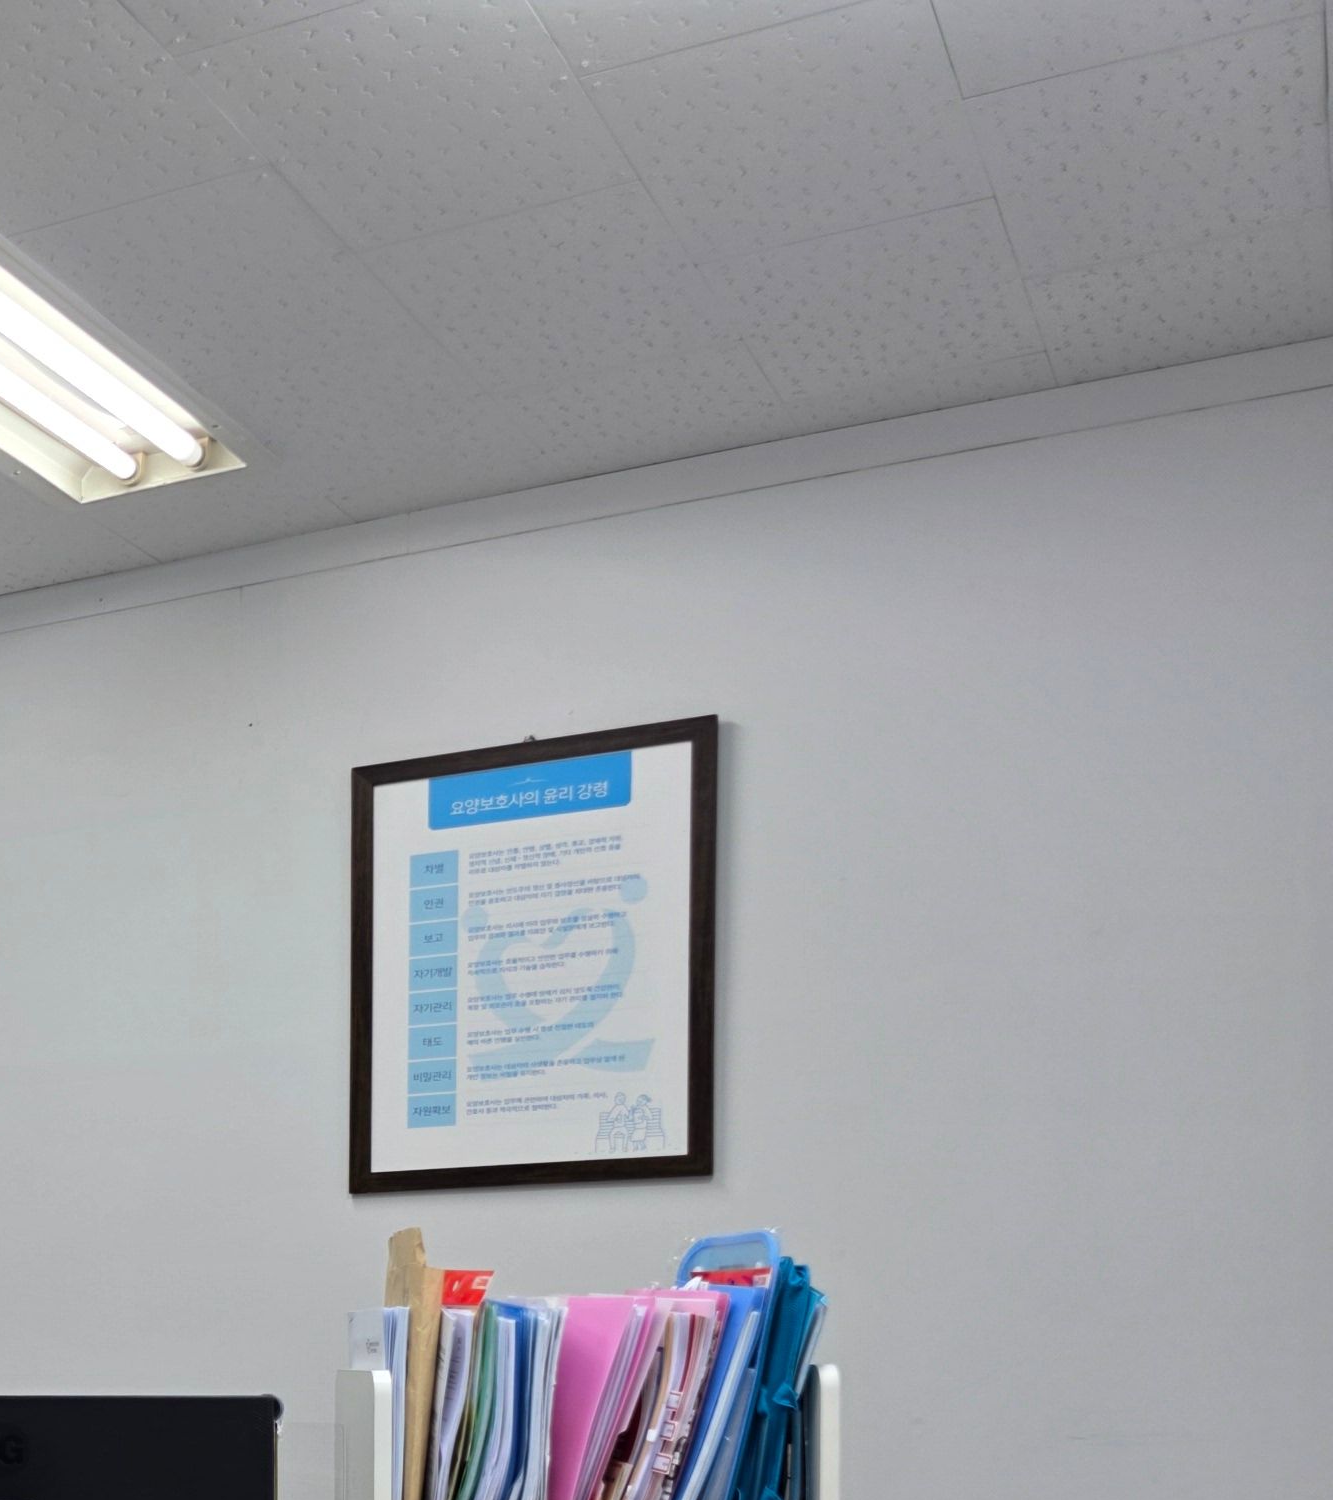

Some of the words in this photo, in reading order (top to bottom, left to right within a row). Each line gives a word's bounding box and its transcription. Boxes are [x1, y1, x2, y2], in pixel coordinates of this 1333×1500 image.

[450, 790, 539, 815] 요양보호사의
[544, 784, 573, 805] 윤리
[577, 780, 609, 799] 강령
[423, 863, 444, 874] 차별
[423, 897, 444, 910] 인권
[423, 933, 444, 944] 보고
[413, 1001, 453, 1014] 자기관리
[422, 1036, 444, 1047] 태도
[413, 1070, 452, 1083] 비밀관리
